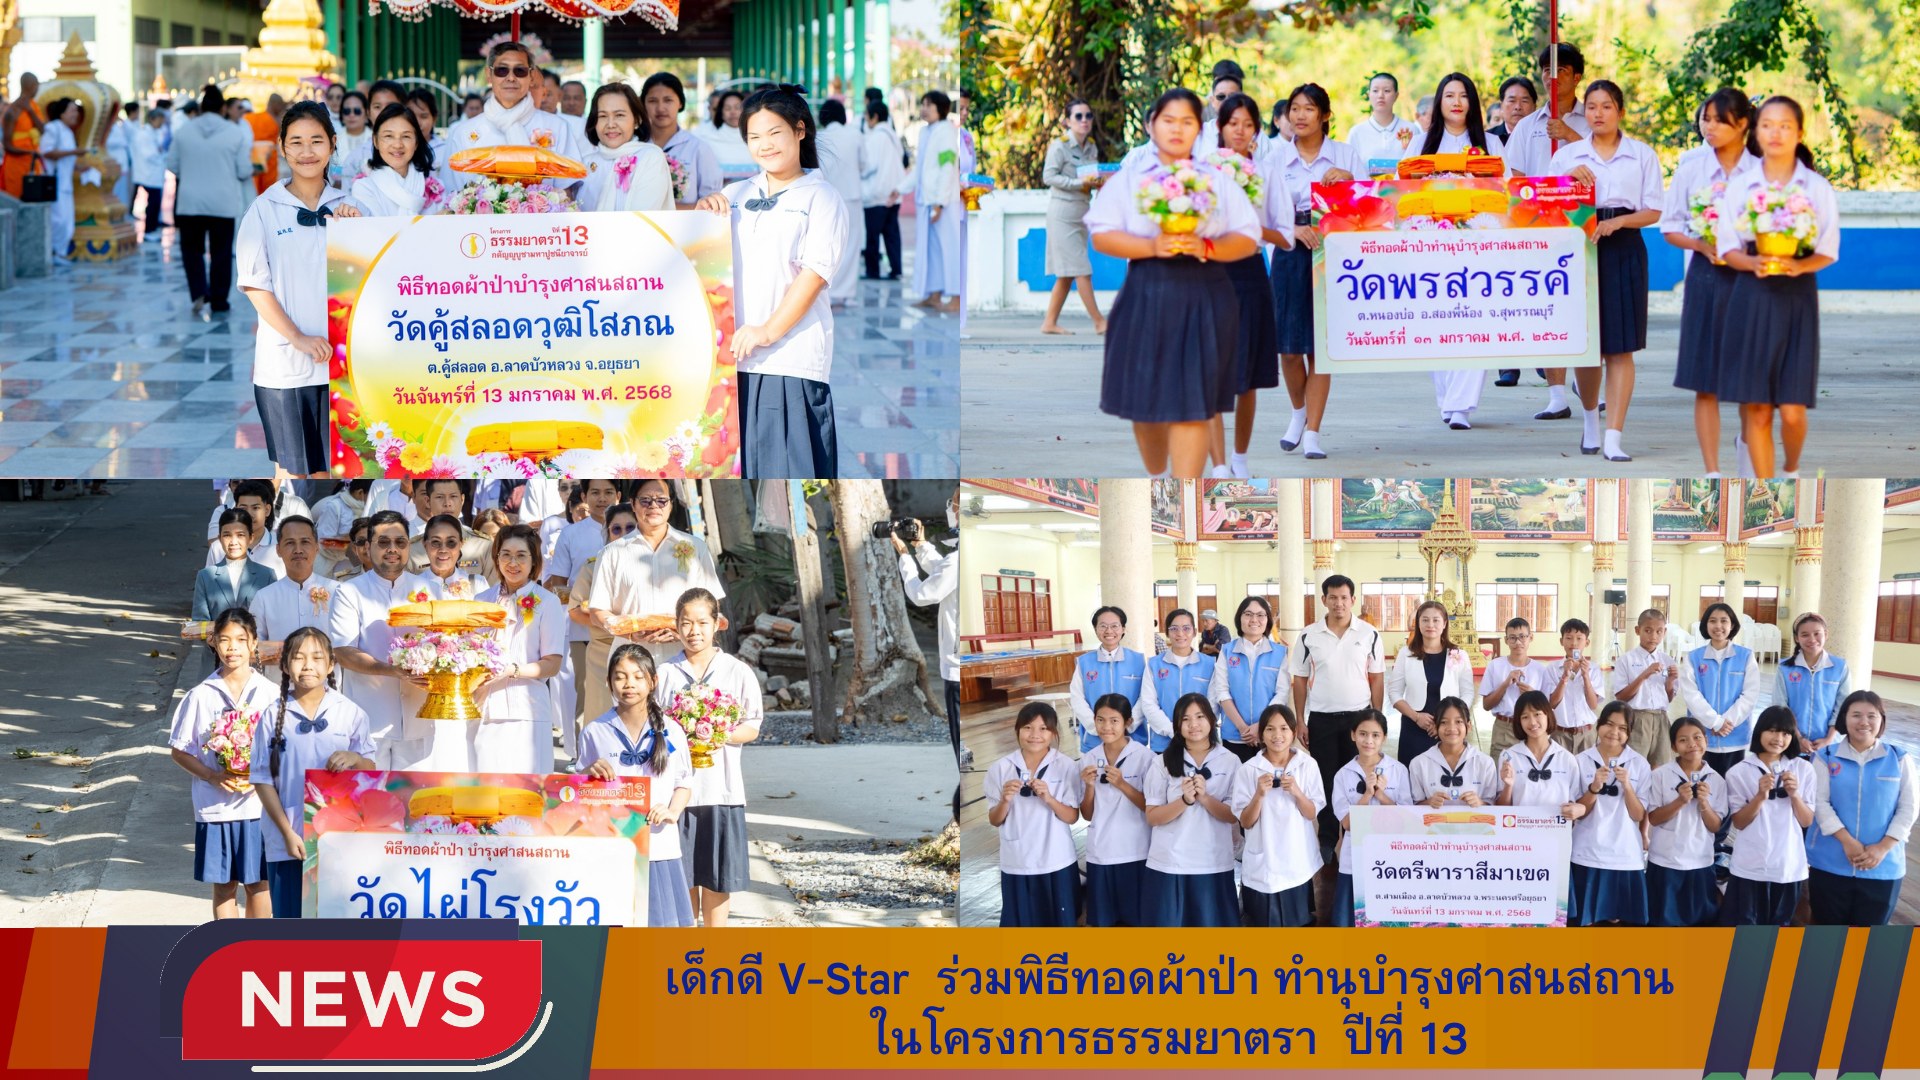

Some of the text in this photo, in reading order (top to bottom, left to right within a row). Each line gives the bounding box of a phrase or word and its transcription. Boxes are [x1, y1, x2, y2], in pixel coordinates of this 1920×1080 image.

[490, 225, 589, 247] ธรรมยาตรา 13
[1360, 239, 1548, 256] พิธีทอดผ้าป่าทำนุบำรุงศาสนสถาน
[397, 273, 664, 299] พิธีทอดผ้าป่าบำรุงศาสนสถาน
[1336, 252, 1574, 301] วัดพรสวรรค์
[1358, 303, 1554, 321] ต.หนองบ่อ อ.สองพี่น้อง จ.สุพรรณบุรี
[387, 300, 674, 352] วัดคู้สลอดวุฒิโสภณ
[1346, 326, 1406, 346] วันจันทร์ที่
[1439, 333, 1490, 344] มกราคม
[1497, 331, 1524, 342] พ.ศ.
[1533, 332, 1568, 341] ๒๕๖๘
[428, 357, 639, 378] ต.คู้สลอด อ.ลาดบัวหลวง จ.อยุธยา
[393, 380, 672, 405] วันจันทร์ที่ 13 มกราคม พ.ศ. 2568
[384, 840, 570, 862] พิธีทอดผ้าป่า บำรุงศาสนสถาน
[1372, 860, 1549, 881] วัดตรีพาราสีมาเขต
[1391, 905, 1431, 915] วันจันทร์ที่
